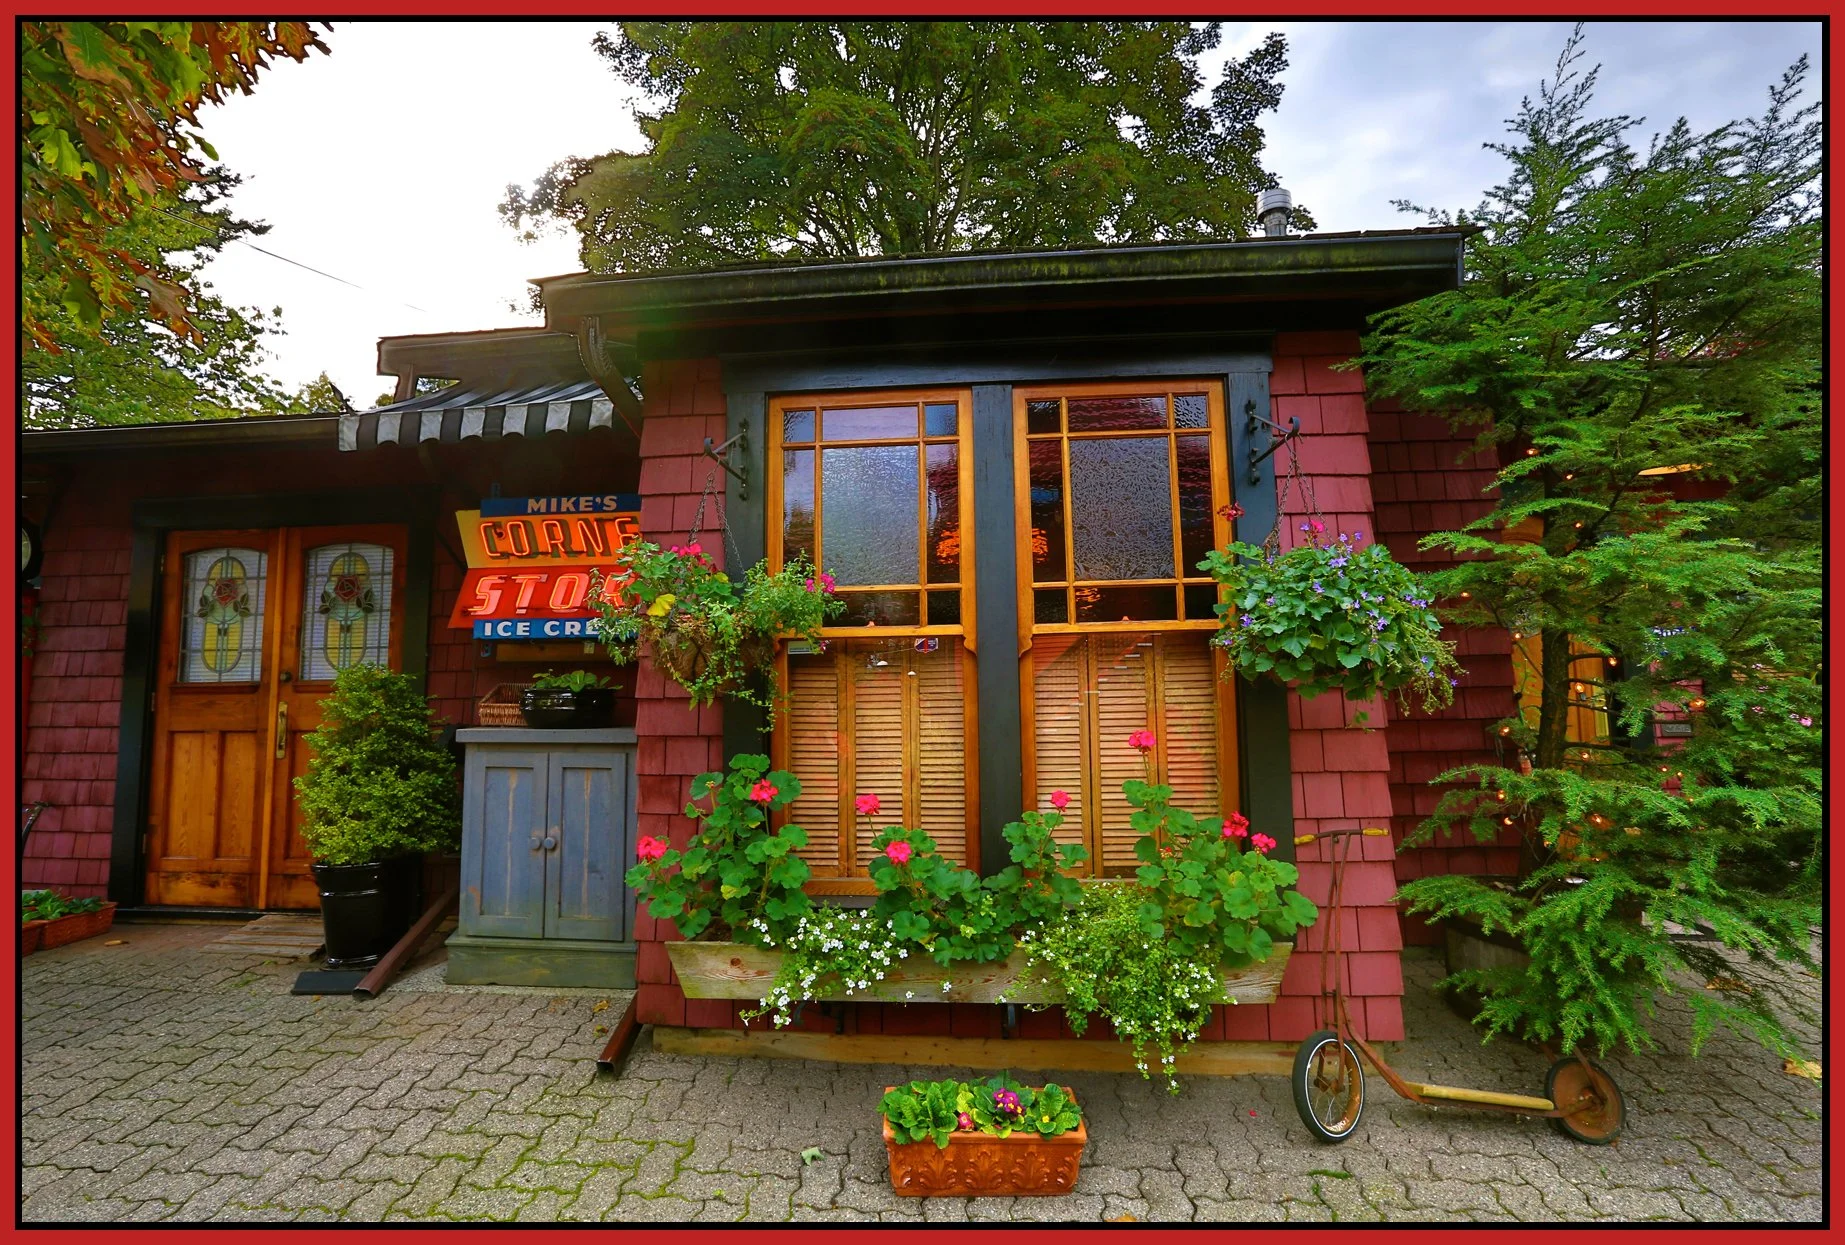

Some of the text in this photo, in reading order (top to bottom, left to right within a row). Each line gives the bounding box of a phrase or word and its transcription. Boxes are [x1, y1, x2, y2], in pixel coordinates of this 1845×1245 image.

[527, 495, 618, 513] MIKE'S
[484, 621, 618, 636] ICE CRE
